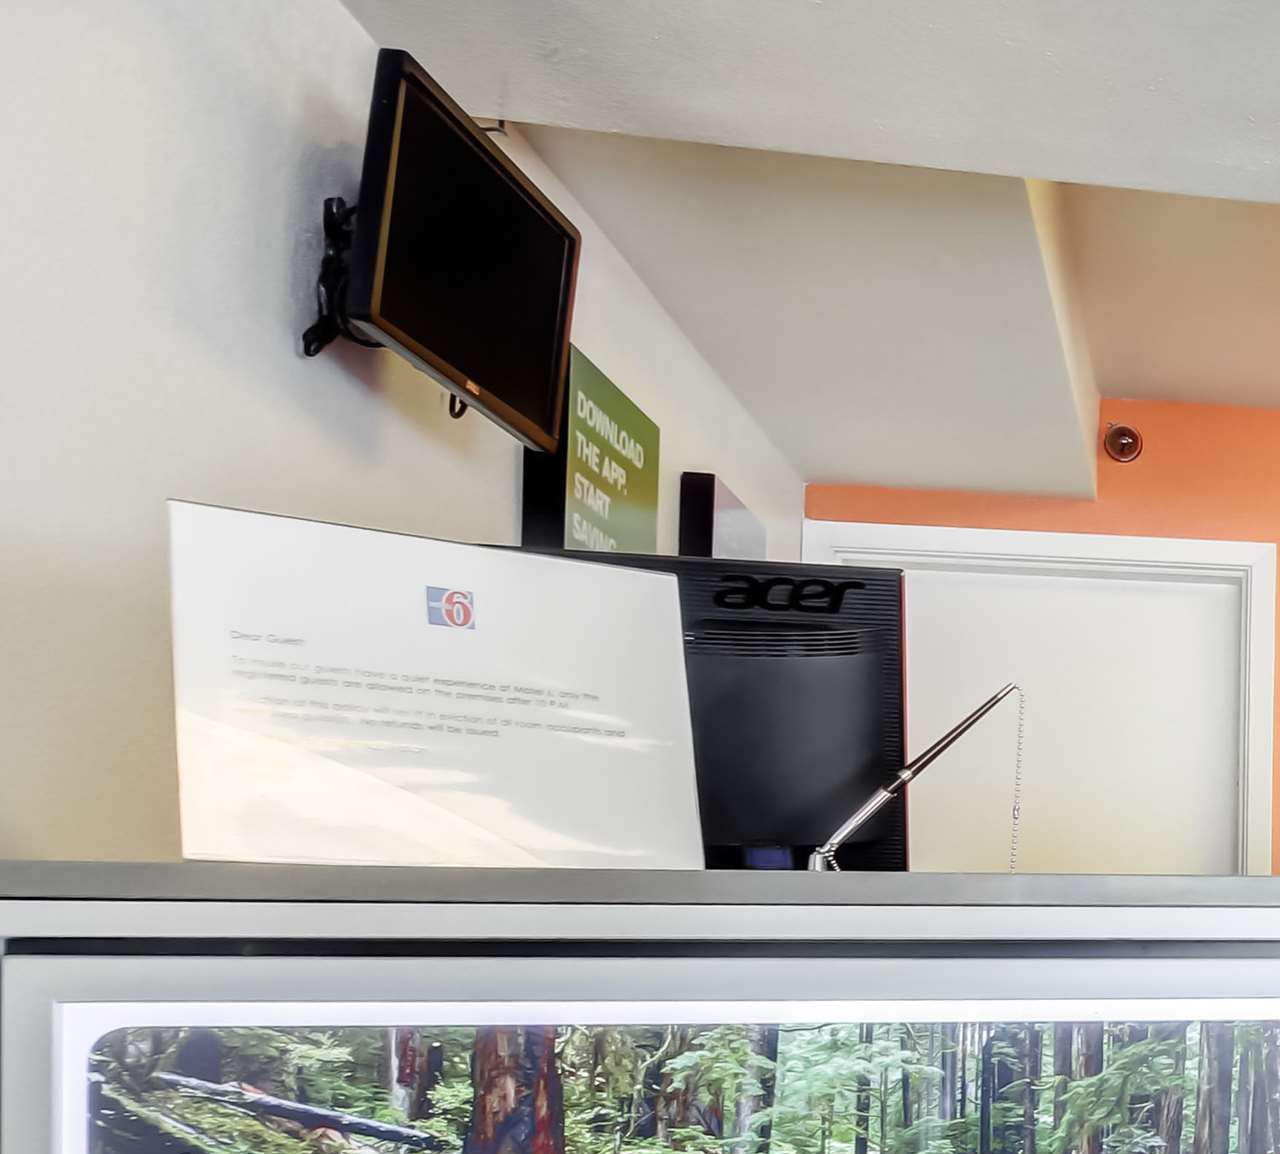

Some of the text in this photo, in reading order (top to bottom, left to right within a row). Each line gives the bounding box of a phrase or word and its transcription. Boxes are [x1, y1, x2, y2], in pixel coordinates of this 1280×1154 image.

[576, 390, 645, 470] DOWNLOAD
[575, 429, 628, 496] THE APP.
[573, 471, 611, 520] START
[442, 590, 473, 629] 6
[713, 575, 867, 614] acer
